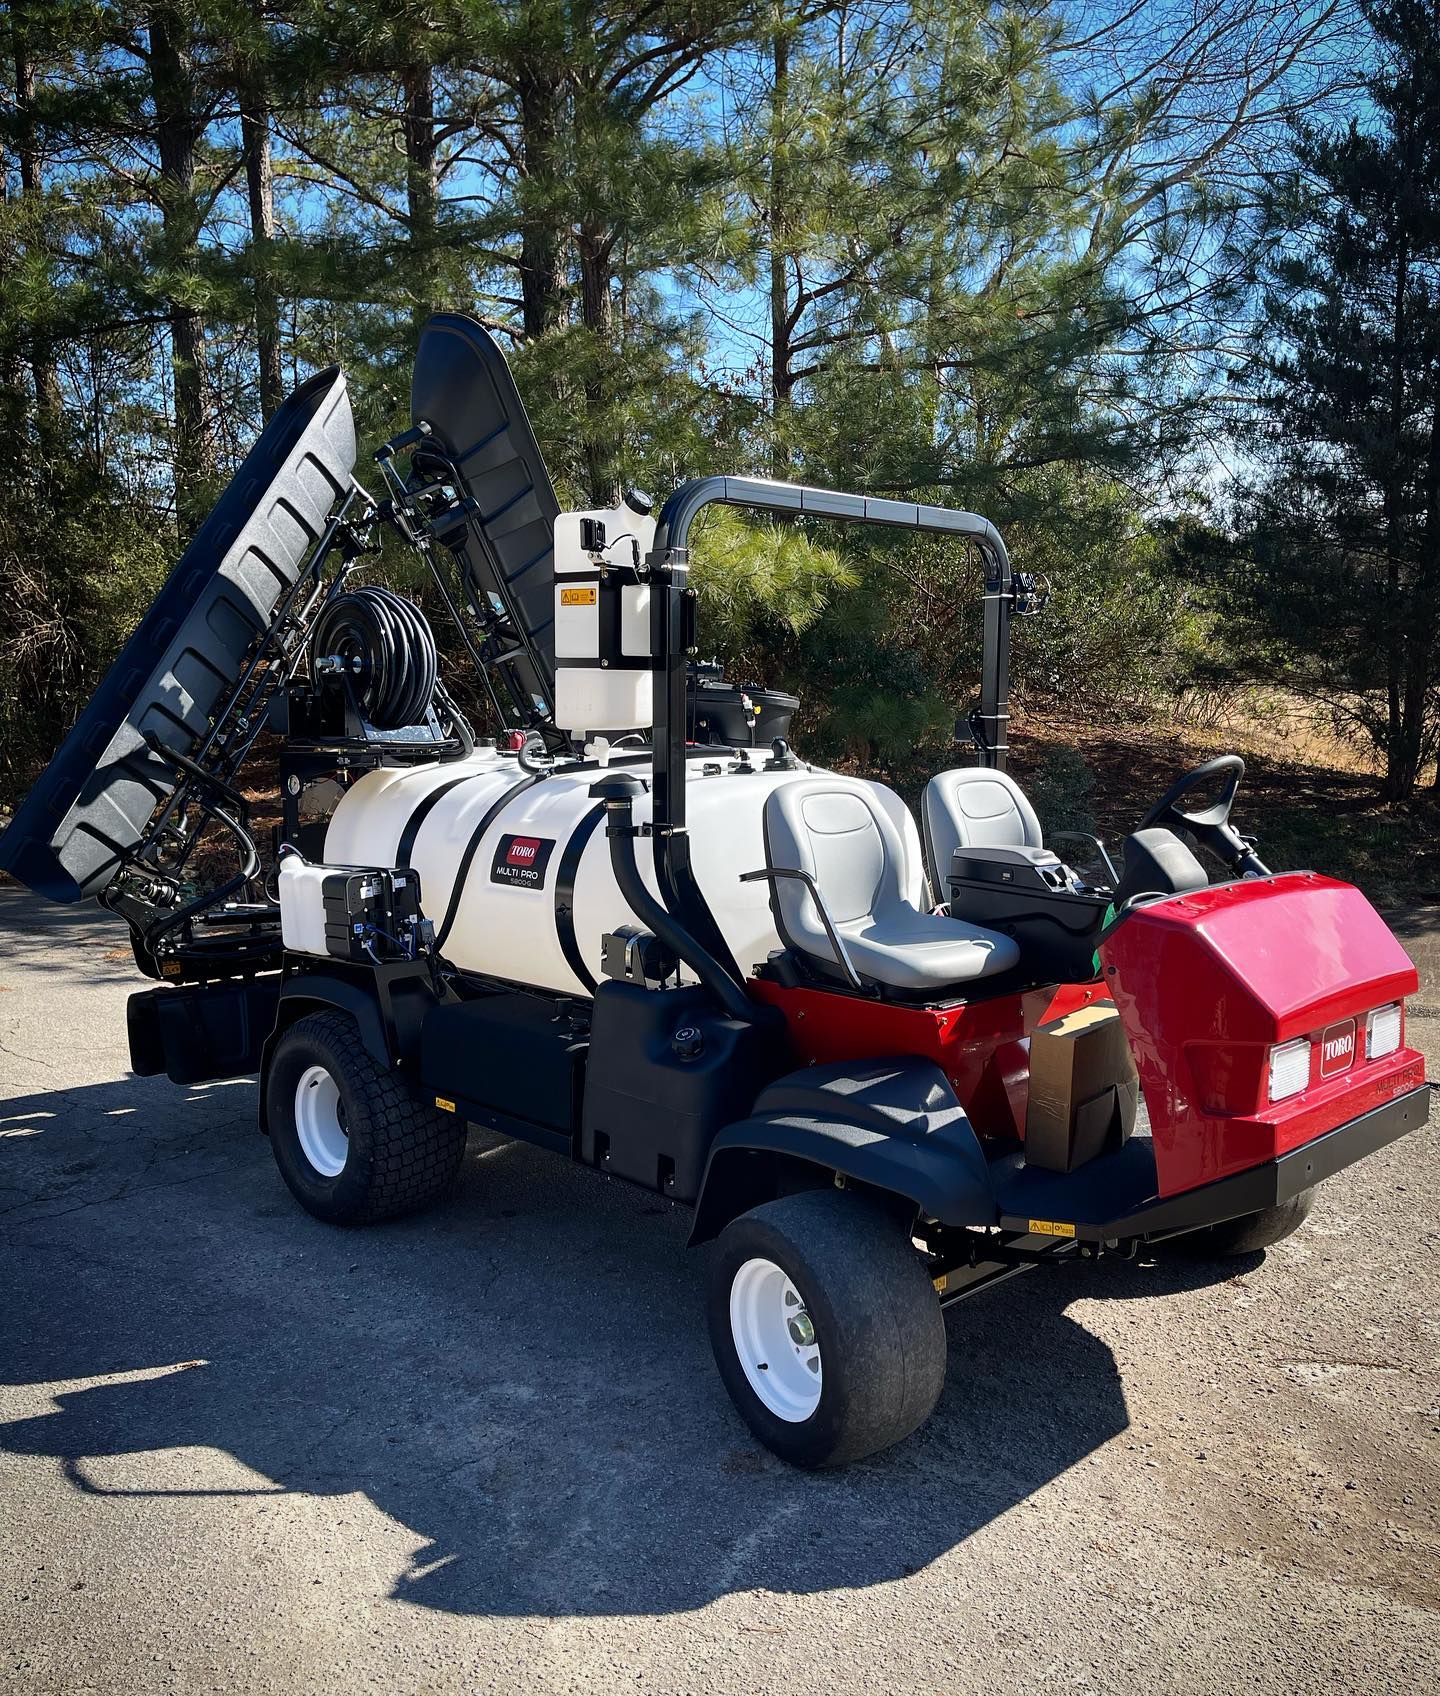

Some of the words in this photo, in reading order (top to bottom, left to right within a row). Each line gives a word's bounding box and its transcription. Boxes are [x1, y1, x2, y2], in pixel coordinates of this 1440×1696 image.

[511, 846, 535, 857] TORO
[496, 866, 518, 877] MULTI
[521, 869, 539, 880] PRO
[1325, 1034, 1352, 1061] TORO
[1376, 1075, 1400, 1093] MULTI
[1403, 1064, 1419, 1080] PRO
